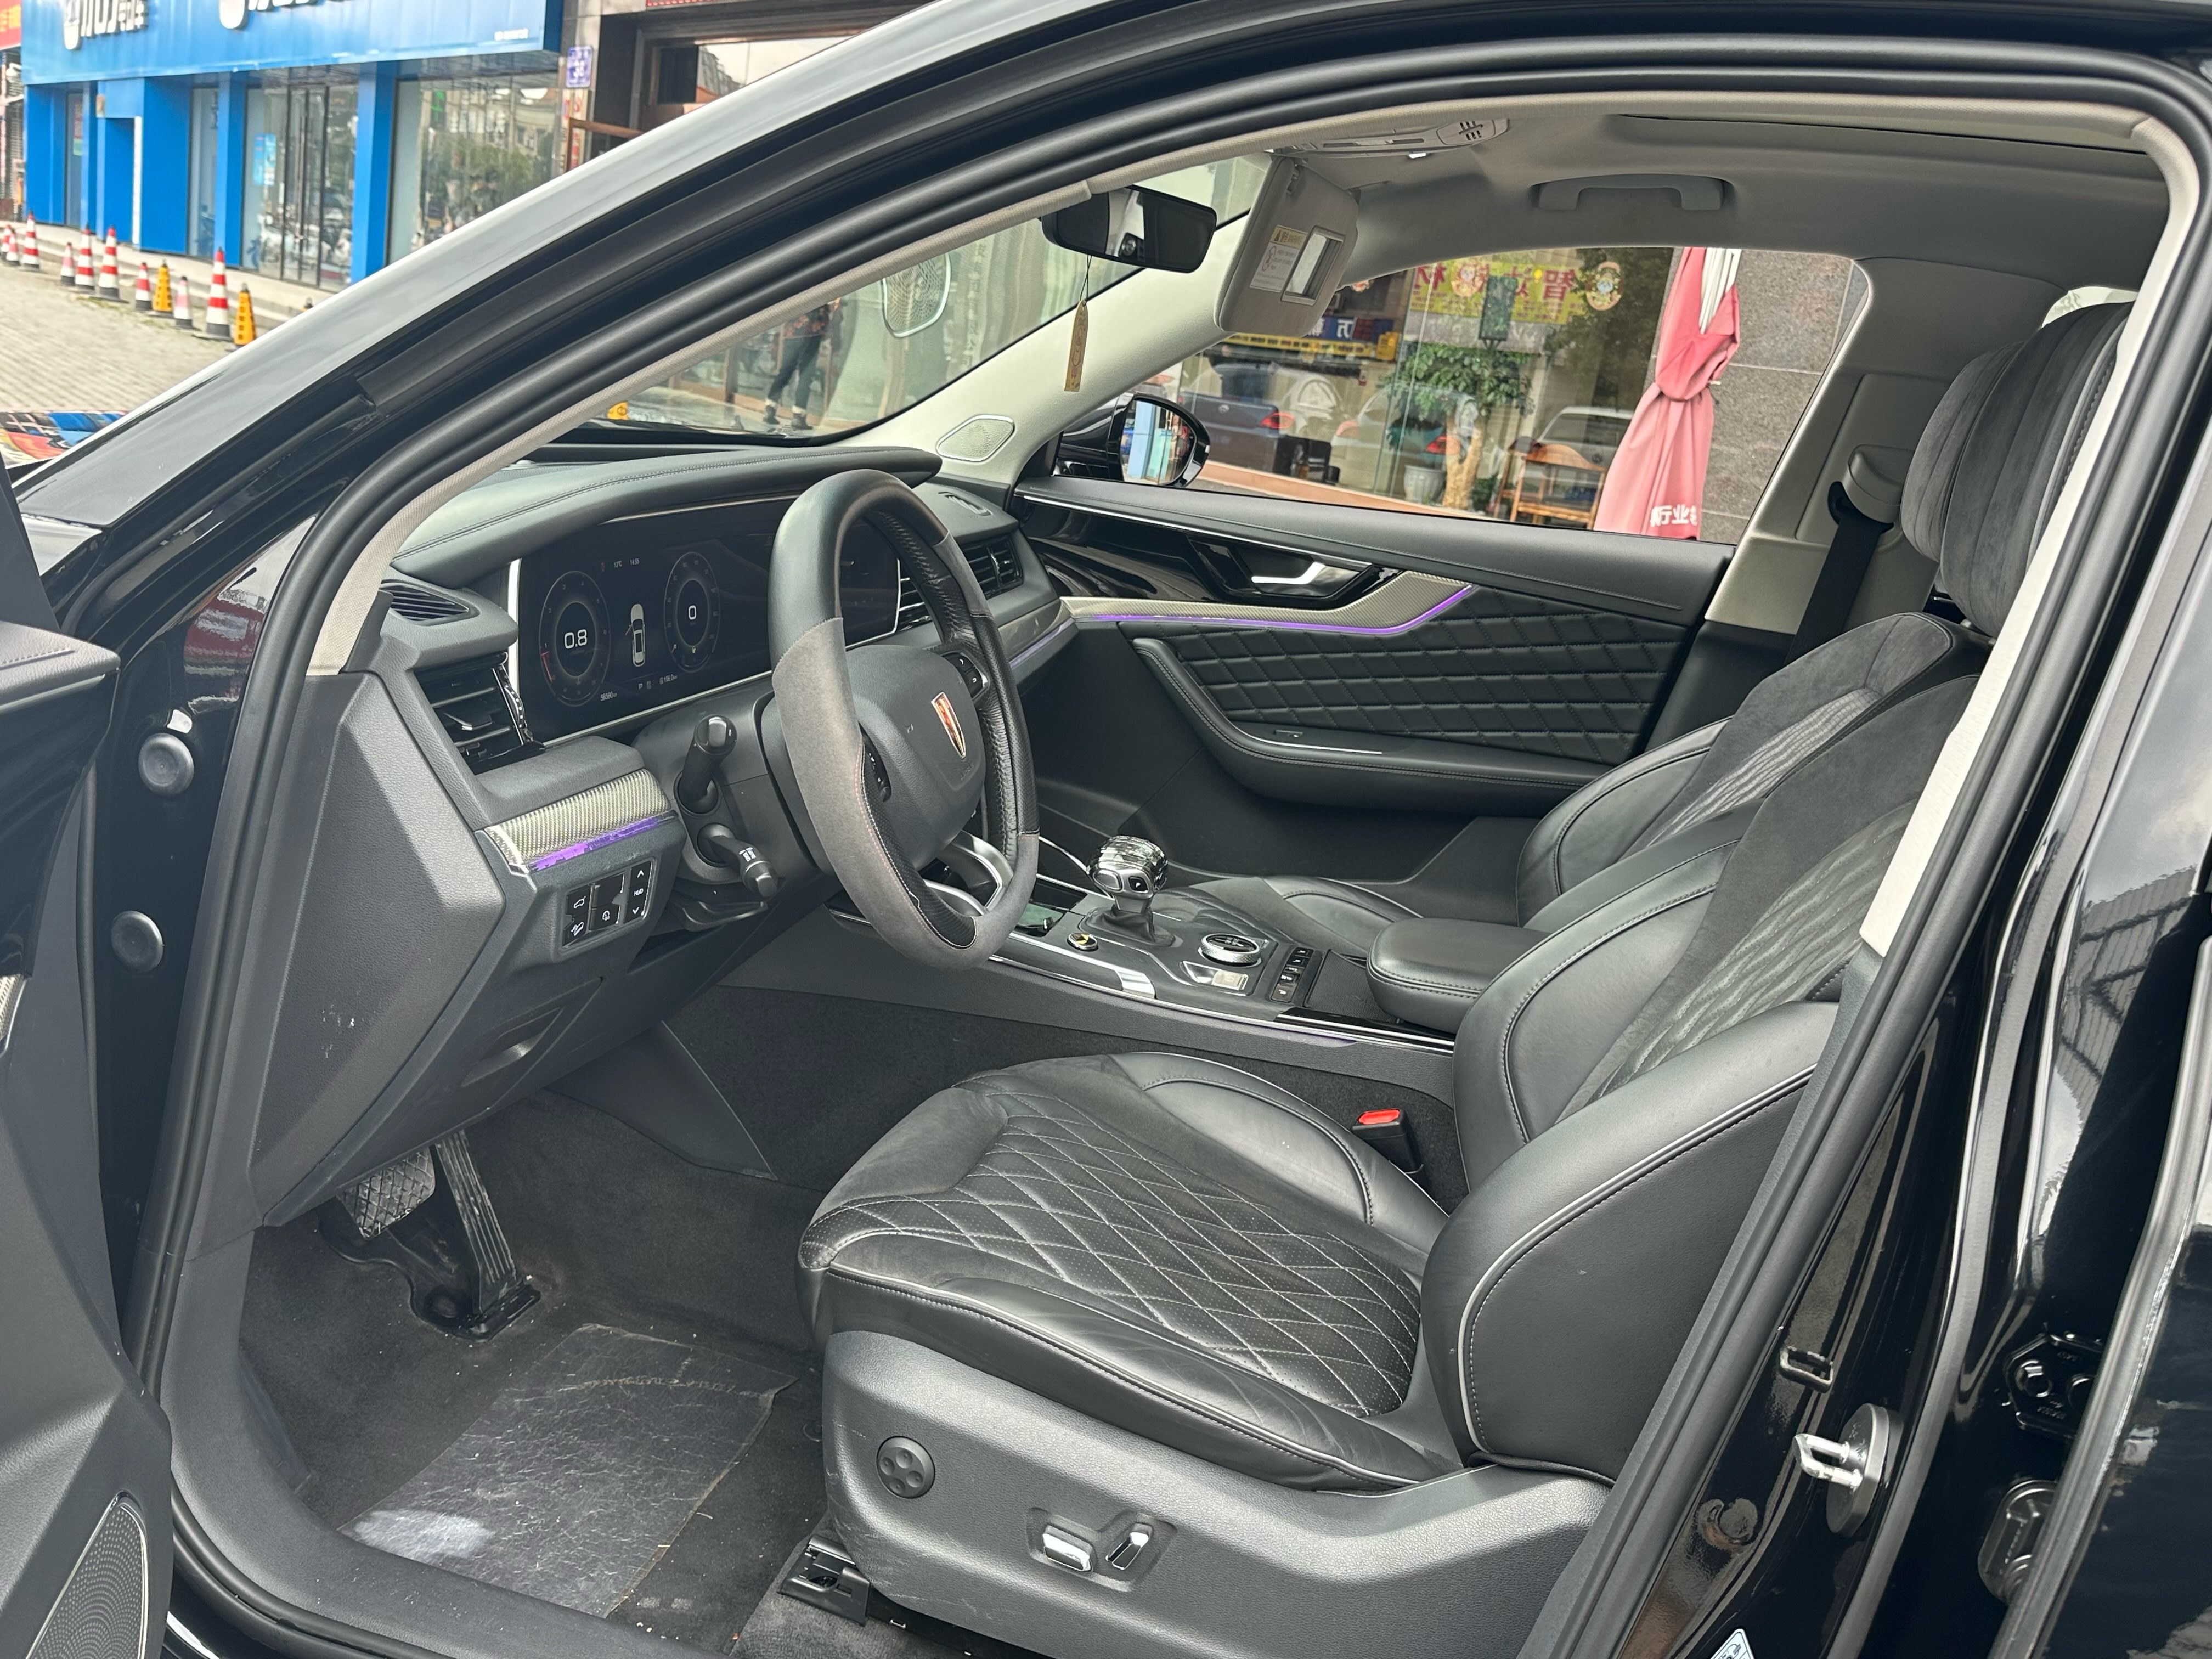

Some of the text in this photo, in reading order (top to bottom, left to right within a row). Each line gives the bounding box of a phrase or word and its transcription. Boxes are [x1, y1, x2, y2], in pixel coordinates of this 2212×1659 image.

[689, 605, 697, 620] 0
[564, 629, 588, 649] 0.8
[633, 888, 644, 897] HUD
